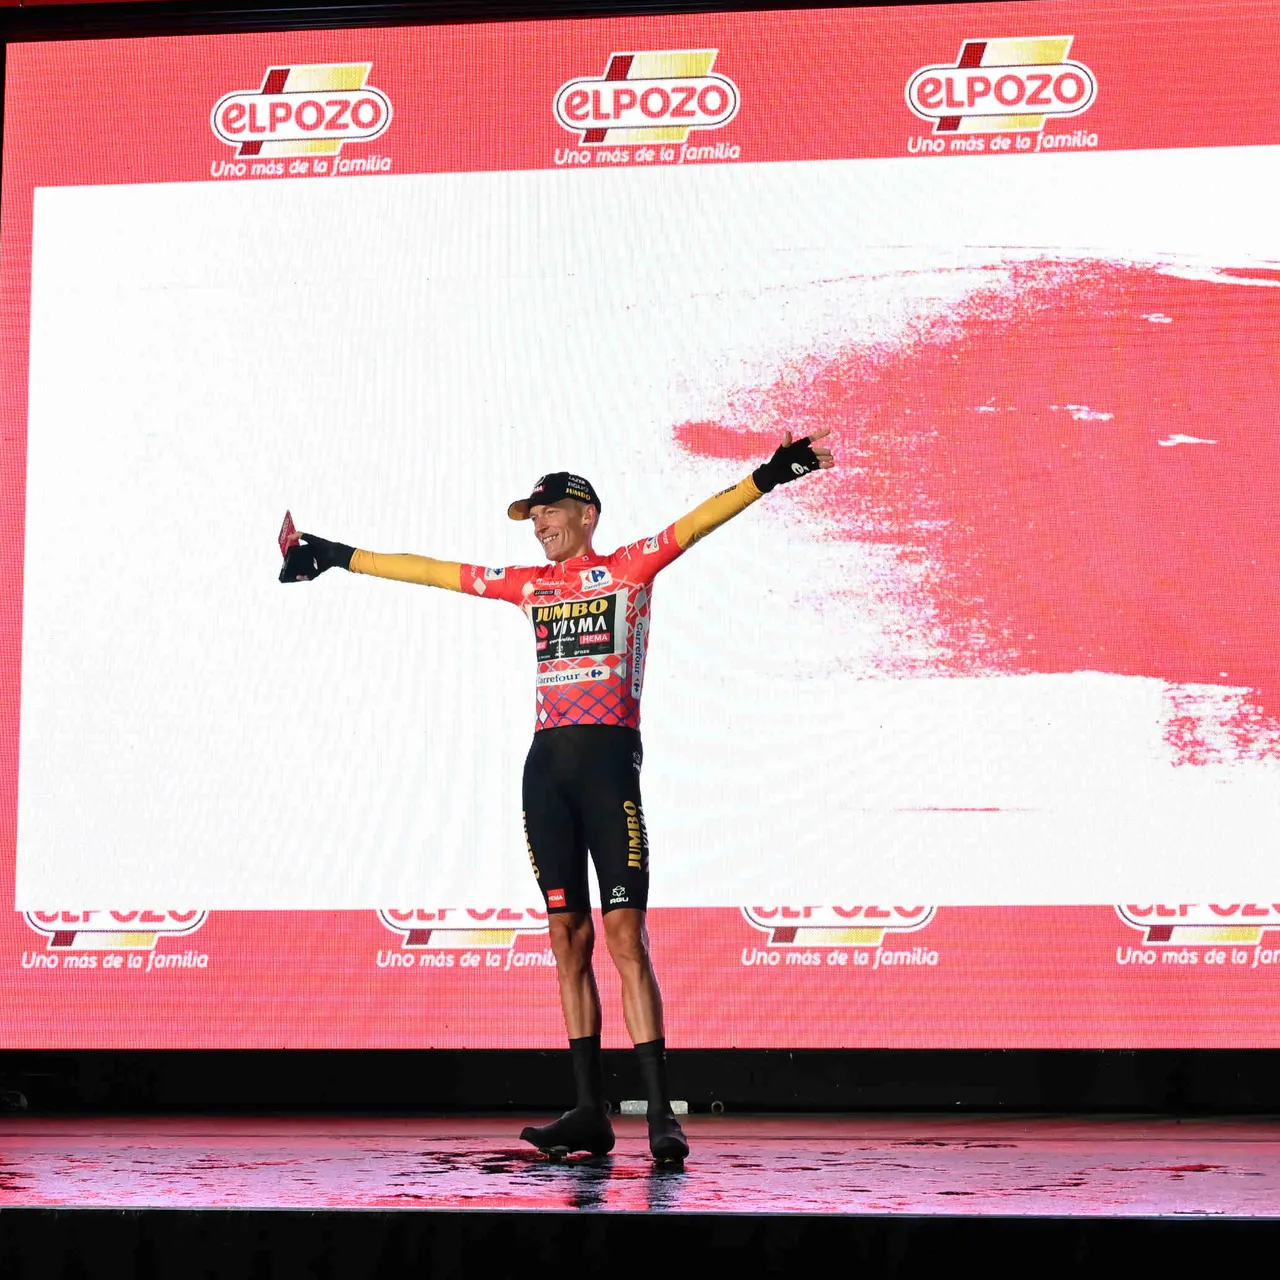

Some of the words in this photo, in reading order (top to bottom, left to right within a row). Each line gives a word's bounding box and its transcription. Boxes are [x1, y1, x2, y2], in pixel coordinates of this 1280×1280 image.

[907, 136, 945, 152] Uno
[991, 136, 1011, 150] de
[1015, 135, 1030, 149] la
[1035, 130, 1099, 152] familia
[554, 148, 591, 165] Uno
[635, 148, 655, 162] de
[660, 147, 674, 161] la
[678, 143, 741, 164] familia
[210, 160, 246, 177] Uno
[289, 160, 309, 174] de
[313, 159, 328, 173] la
[330, 155, 392, 176] familia
[536, 599, 609, 622] JUMBO
[552, 615, 607, 636] VISMA
[583, 634, 608, 643] HEMA
[634, 622, 644, 674] Carrefour
[623, 800, 642, 870] JUMBO
[22, 951, 59, 969] Uno
[103, 953, 123, 968] de
[128, 953, 142, 968] la
[145, 950, 209, 972] familia
[376, 949, 414, 967] Uno
[460, 952, 480, 967] de
[485, 951, 500, 966] la
[741, 948, 780, 966] Uno
[827, 950, 848, 965] de
[853, 950, 868, 965] la
[873, 947, 939, 969] familia
[1116, 946, 1156, 964] Uno
[1204, 948, 1226, 964] de
[1232, 948, 1247, 963] la
